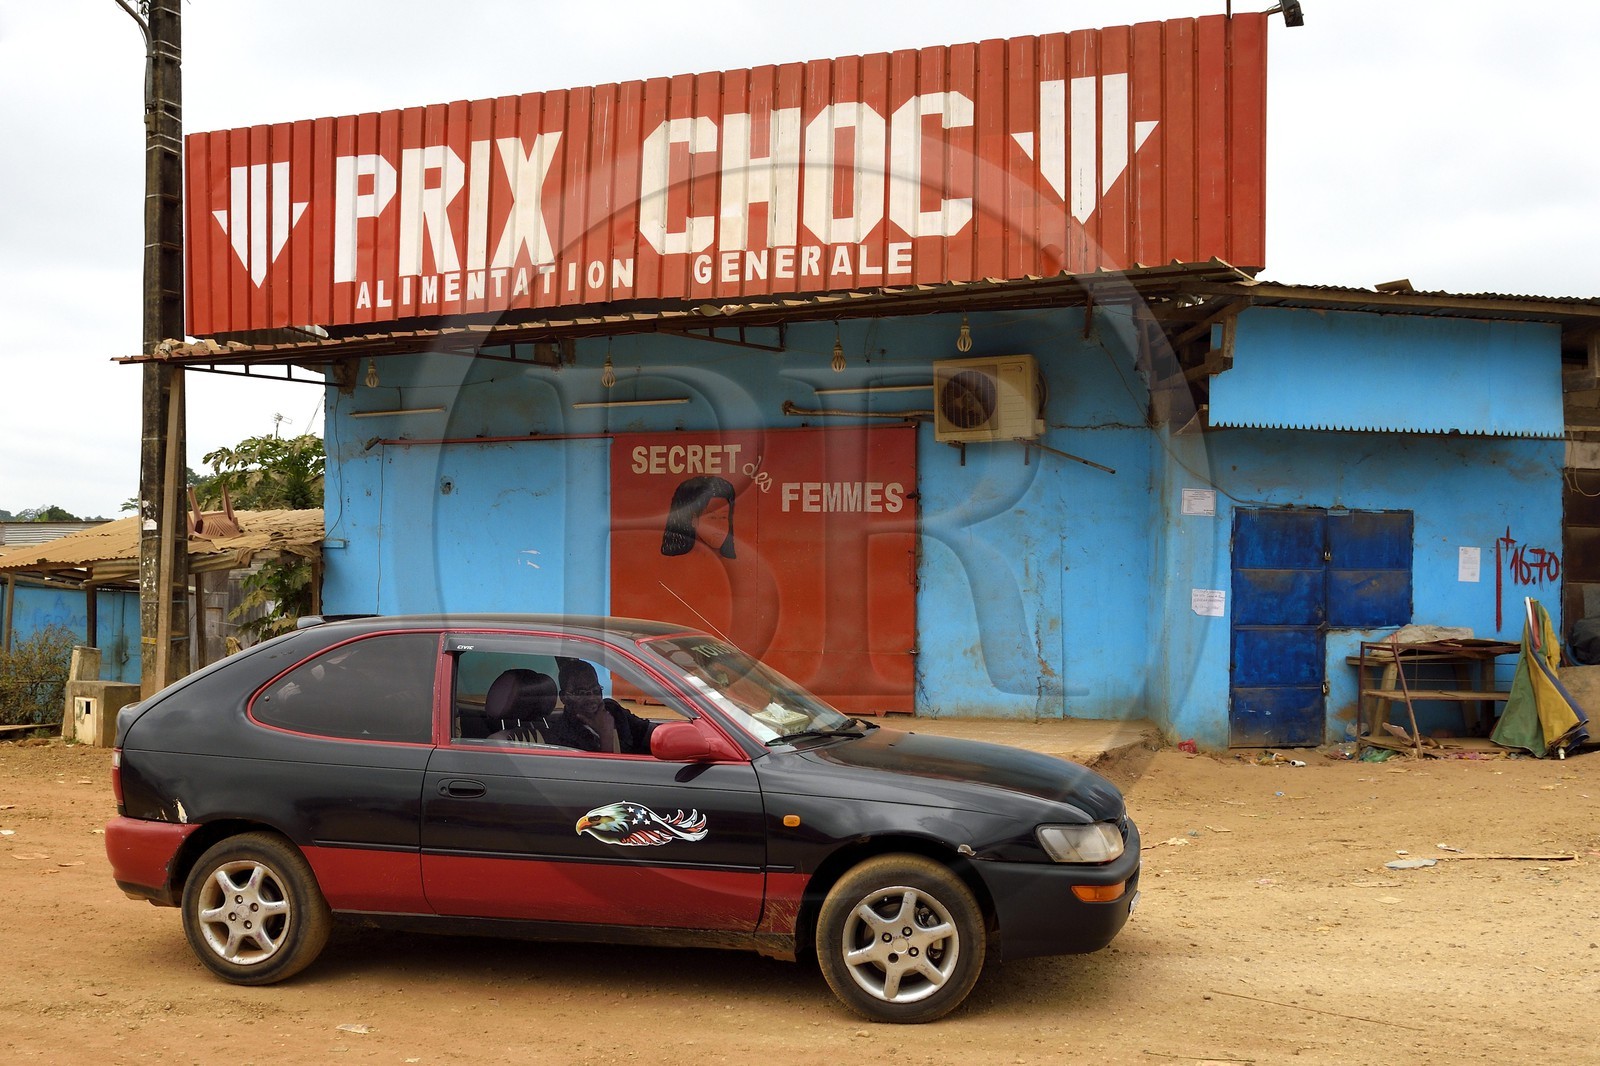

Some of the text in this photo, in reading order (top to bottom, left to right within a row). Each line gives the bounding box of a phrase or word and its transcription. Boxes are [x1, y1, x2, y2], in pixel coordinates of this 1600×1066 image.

[334, 90, 975, 284] PRIX CHOC
[356, 241, 913, 310] ALIMENTATION GENERALE
[631, 444, 904, 513] SECRET des FEMMES
